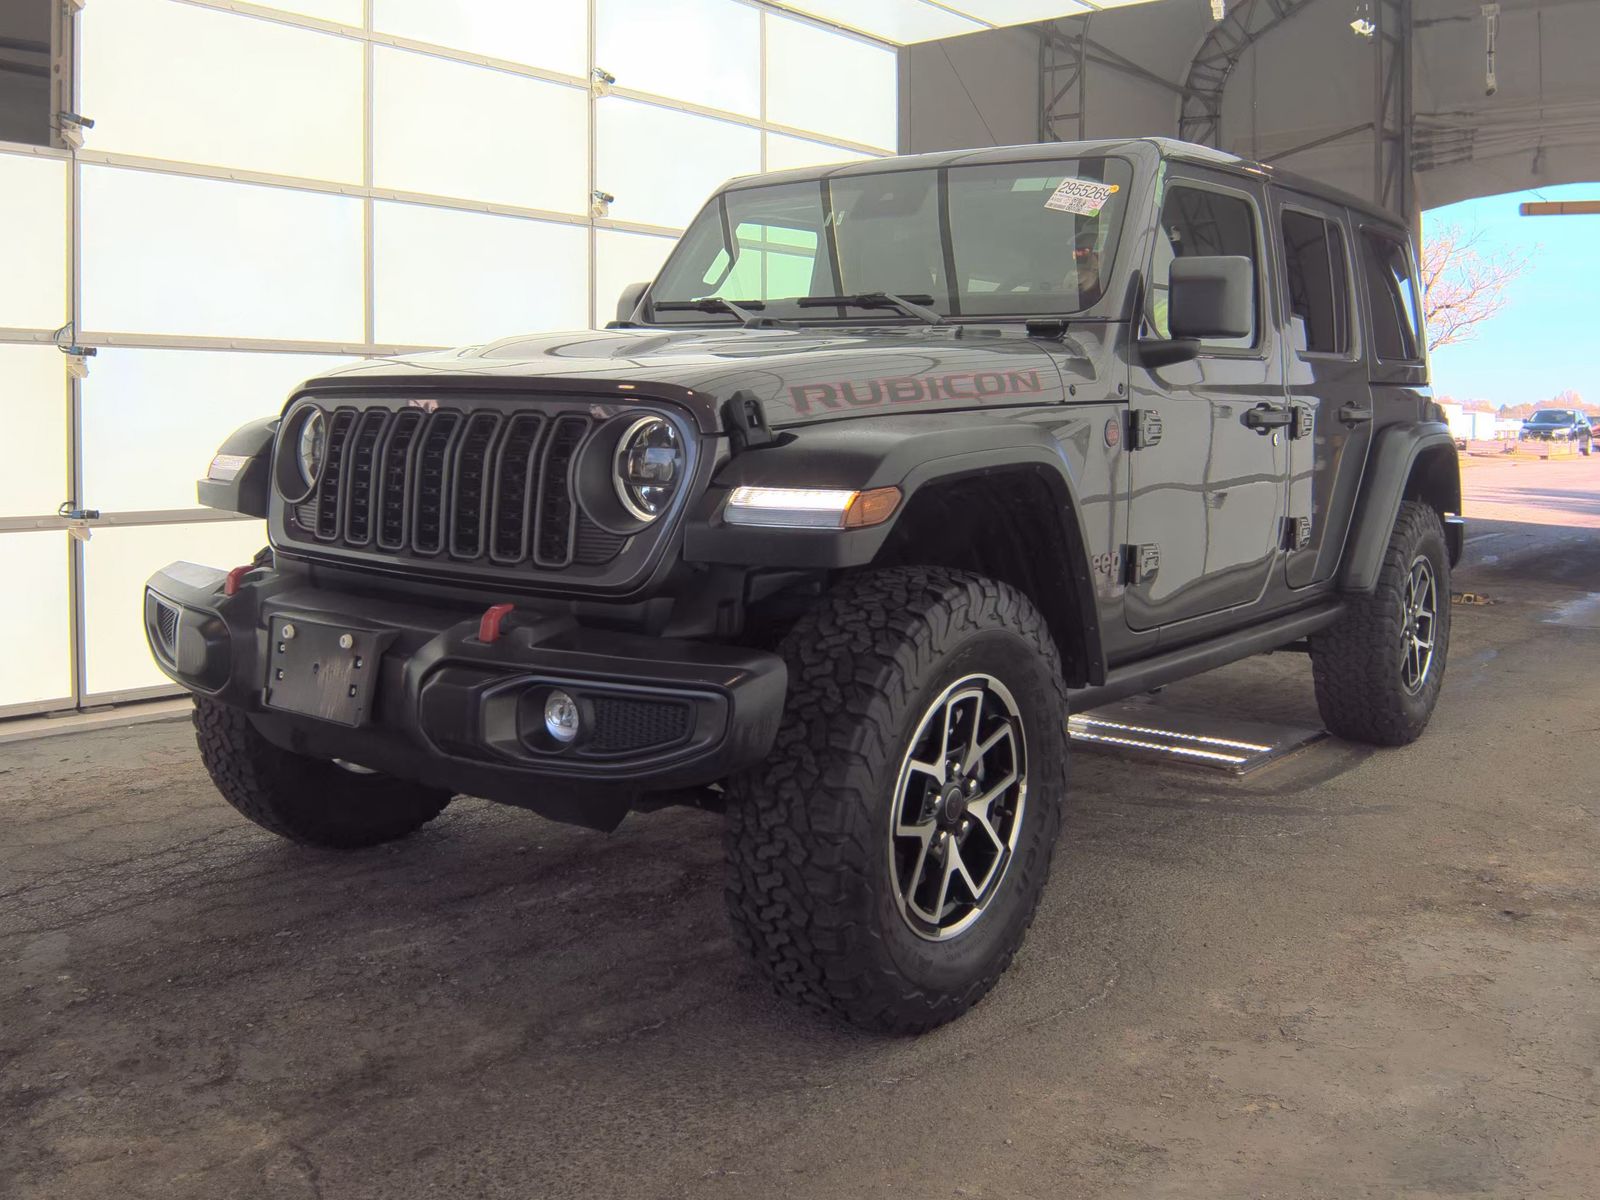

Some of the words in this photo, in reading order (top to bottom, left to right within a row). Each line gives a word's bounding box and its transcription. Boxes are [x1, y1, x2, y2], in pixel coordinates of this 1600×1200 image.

[1058, 181, 1110, 201] 2955269
[788, 369, 1042, 414] RUBICON
[1091, 552, 1121, 577] eep
